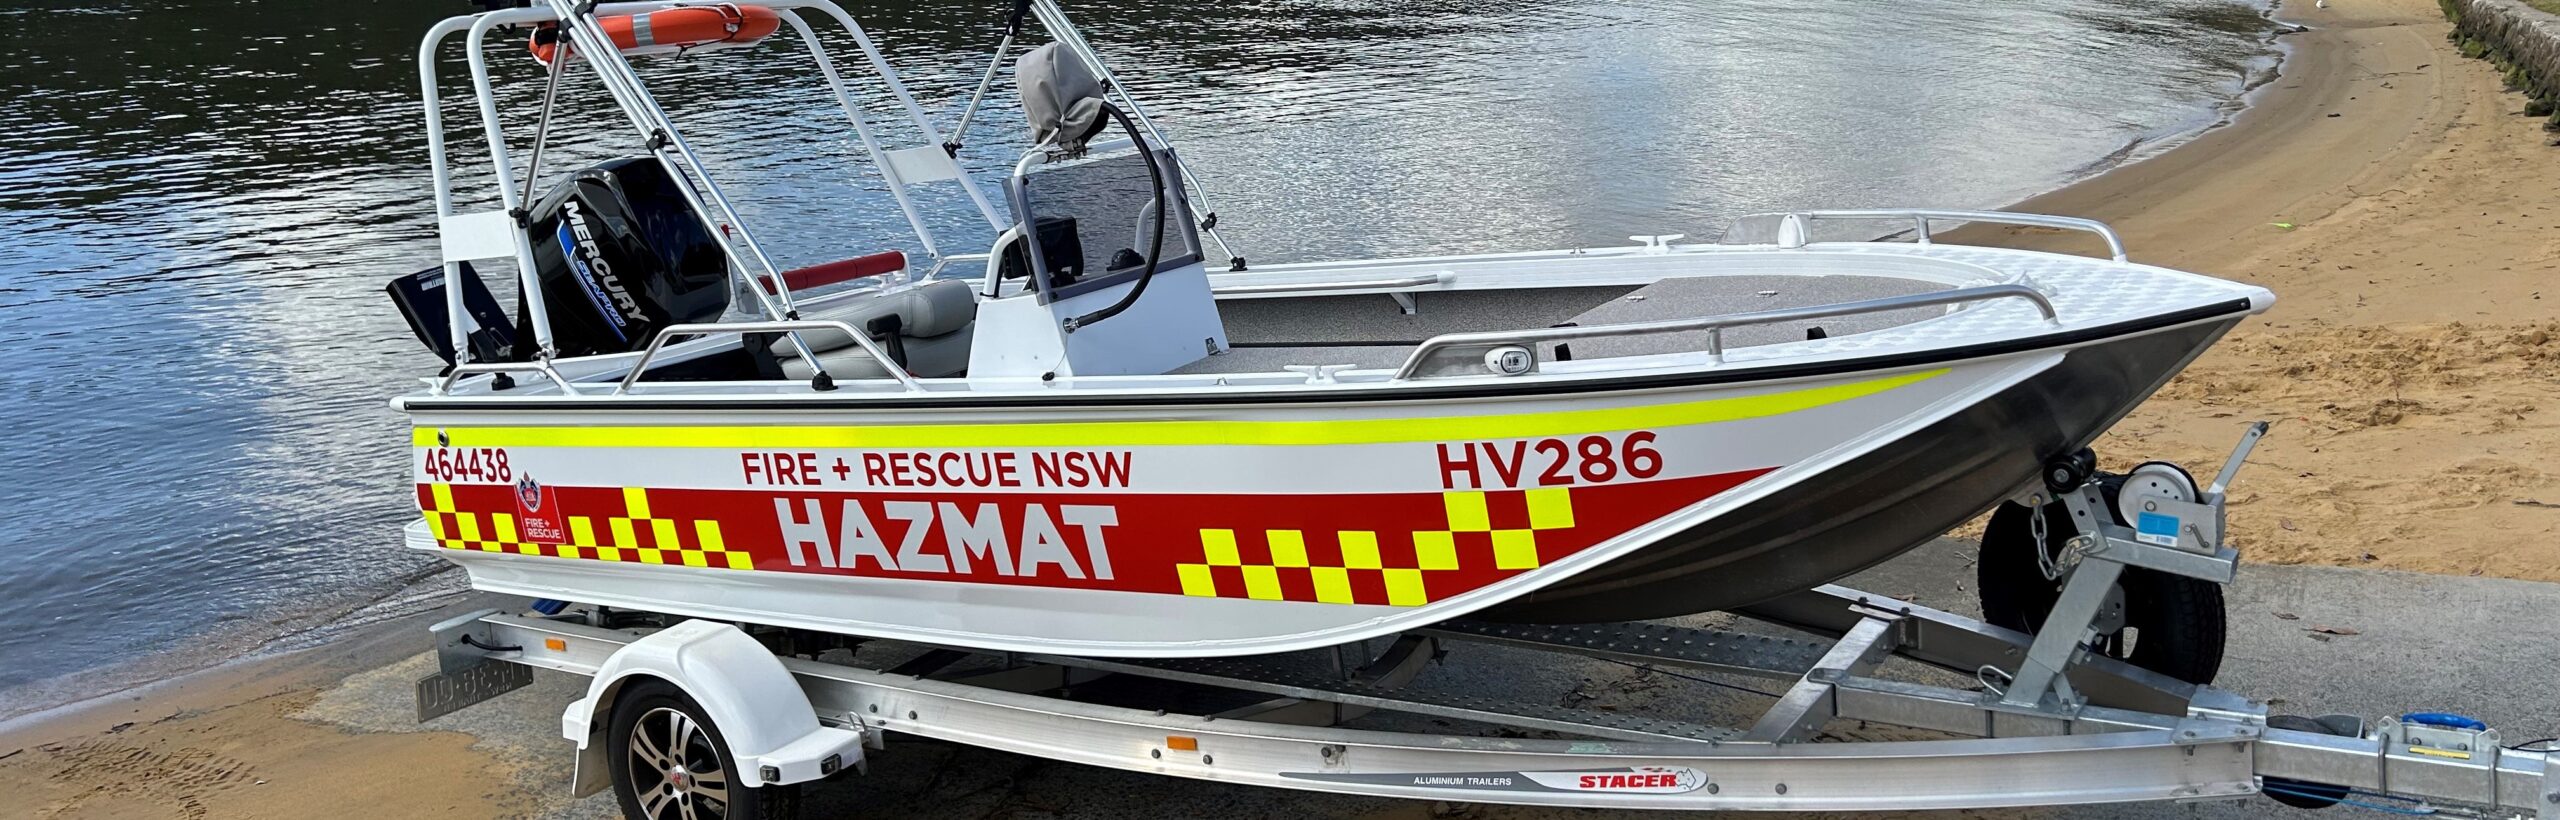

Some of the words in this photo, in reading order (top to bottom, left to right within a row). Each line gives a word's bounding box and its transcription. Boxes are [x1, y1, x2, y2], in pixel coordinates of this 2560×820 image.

[564, 201, 650, 322] MERCURY
[425, 448, 511, 482] 464438
[741, 453, 822, 485] FIRE
[863, 452, 1021, 486] RESCUE
[1032, 451, 1132, 488] NSW
[1436, 431, 1663, 489] HV286
[527, 528, 561, 539] RESCUE
[773, 497, 1119, 580] HAZMAT
[1413, 776, 1463, 785] ALUMINIUM
[1467, 776, 1511, 786] TRAILERS
[1579, 773, 1677, 788] STACER
